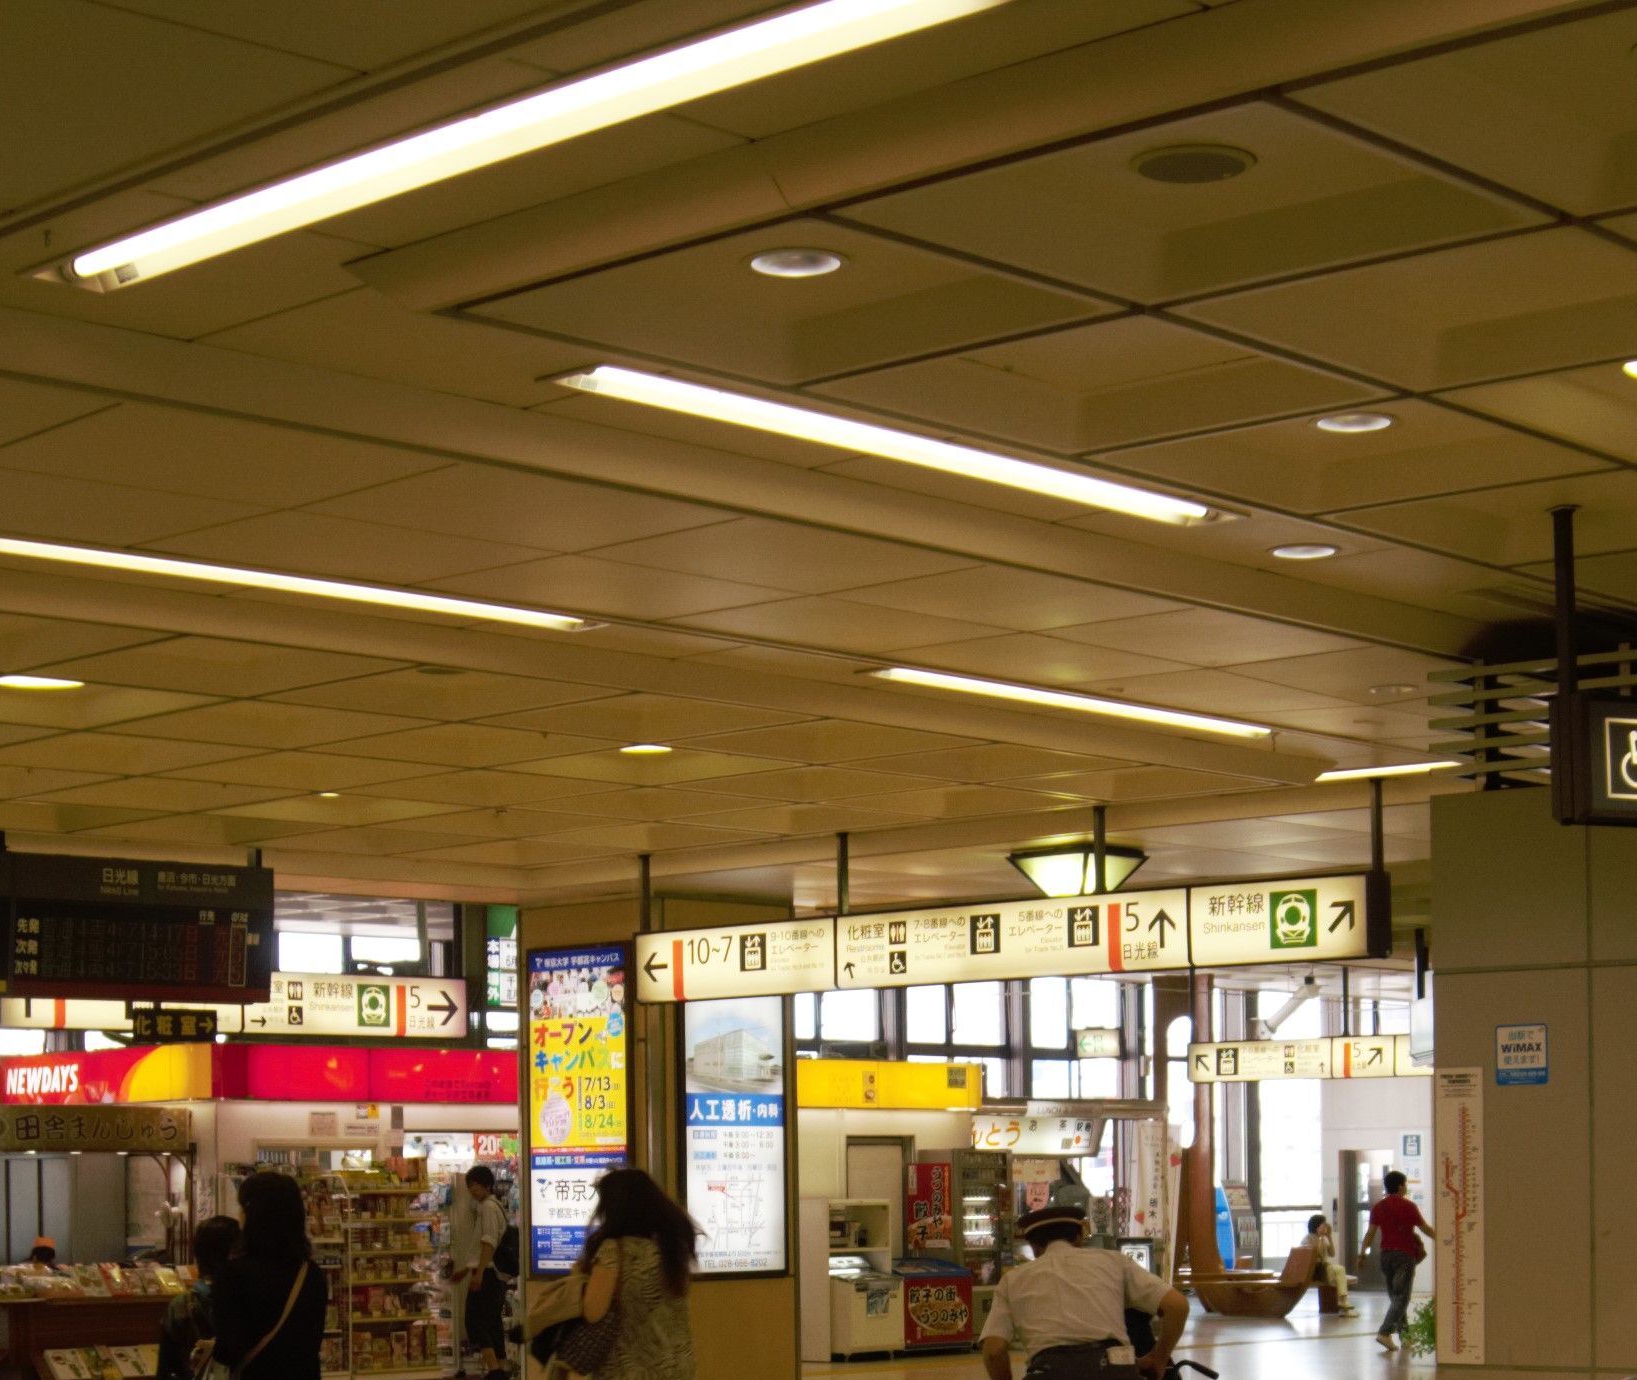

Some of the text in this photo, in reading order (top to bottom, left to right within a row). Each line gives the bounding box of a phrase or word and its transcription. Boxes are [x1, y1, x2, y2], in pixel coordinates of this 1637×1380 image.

[102, 867, 139, 885] 日光線
[1208, 892, 1264, 917] 新幹線
[1018, 908, 1063, 922] 5番線への
[1125, 901, 1139, 931] 5
[17, 917, 40, 934] 先発
[847, 922, 885, 940] 化粧室
[1007, 922, 1063, 937] エレベーター
[1202, 920, 1265, 935] Shinkansen
[913, 930, 966, 944] エレベーター
[15, 938, 38, 955] 次発
[770, 942, 819, 955] エレベーター
[1122, 940, 1159, 961] 日光線
[313, 982, 353, 999] 新幹線
[410, 985, 421, 1009] 5
[309, 1003, 354, 1013] Shinkansen
[135, 1014, 197, 1036] 化粧室
[409, 1015, 435, 1030] 日光線
[533, 1021, 593, 1048] オープン
[1352, 1042, 1361, 1058] 5
[1501, 1042, 1542, 1053] WiMAX
[534, 1047, 624, 1074] キャンパスに
[5, 1063, 80, 1096] NEWDAYS
[584, 1076, 611, 1091] 7/13
[584, 1095, 606, 1110] 8/3
[15, 1114, 178, 1142] 田舎まんじゅう
[584, 1113, 614, 1129] 8/24
[931, 1167, 943, 1241] うつのみやの
[914, 1202, 930, 1241] 餃子
[909, 1287, 957, 1304] 餃子の街
[920, 1306, 969, 1325] うつのみや
